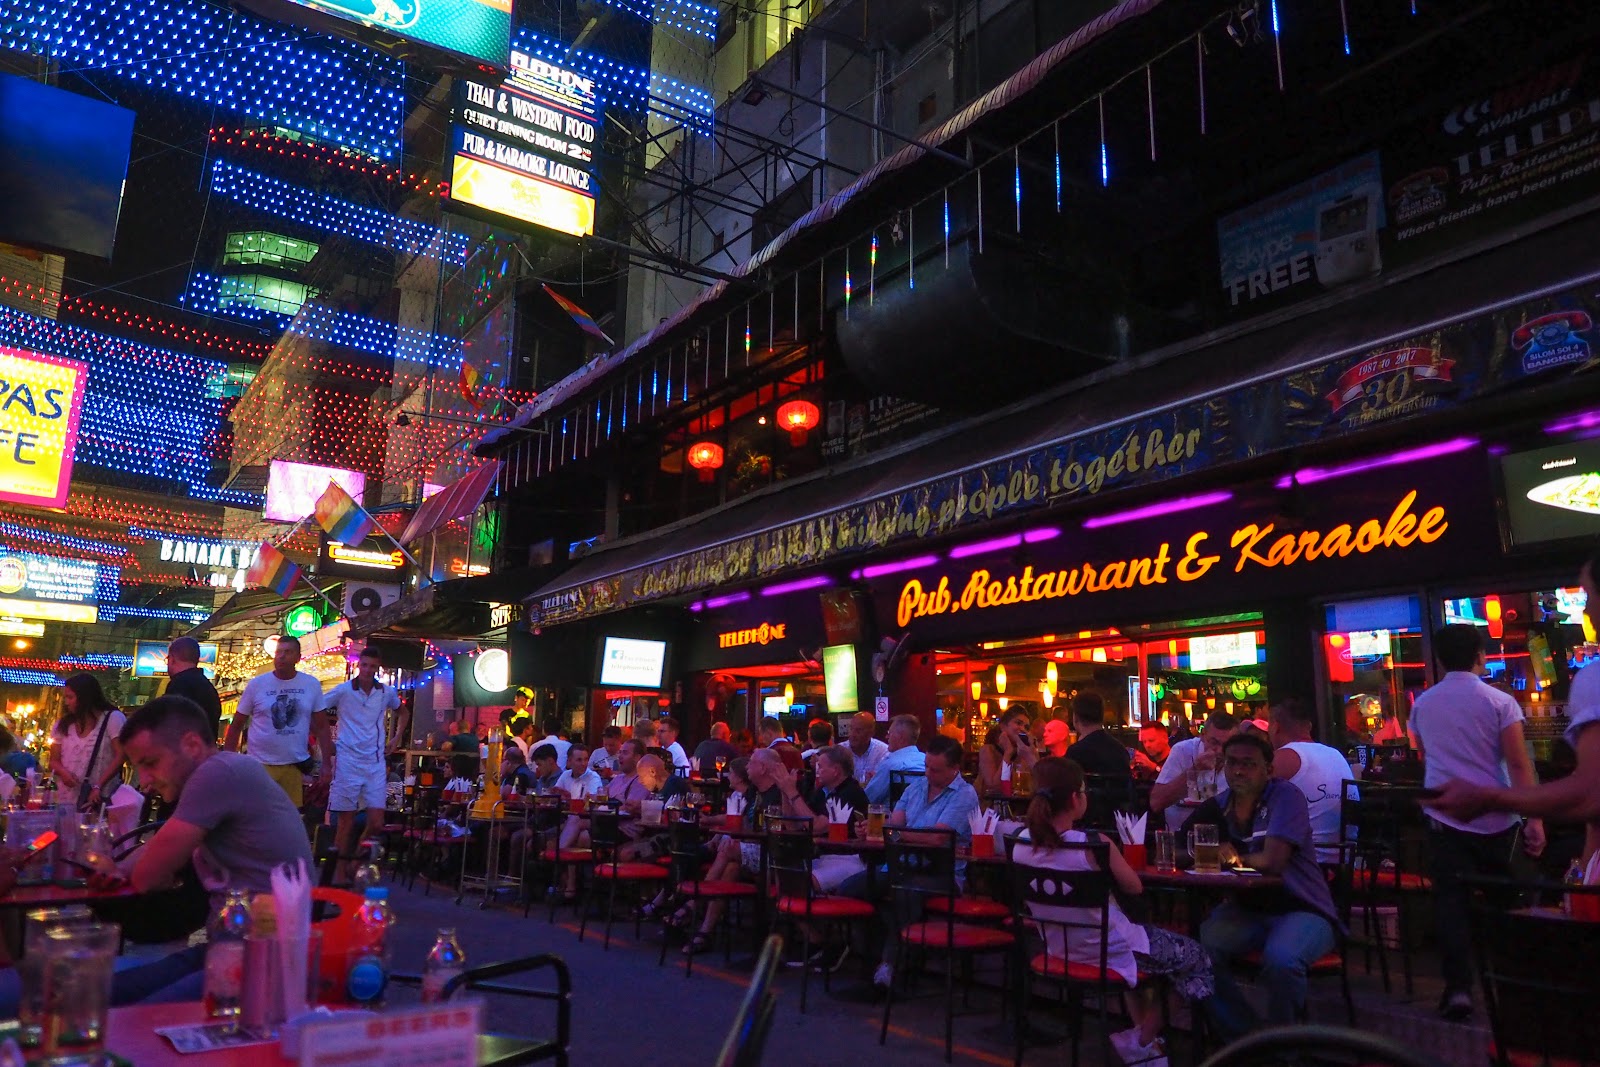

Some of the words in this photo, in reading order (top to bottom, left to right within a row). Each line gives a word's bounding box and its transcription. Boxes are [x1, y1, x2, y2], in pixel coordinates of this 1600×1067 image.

[463, 108, 499, 130] QUIET
[535, 131, 568, 154] ROOM
[466, 80, 496, 109] THAI
[497, 92, 508, 114] &
[511, 96, 563, 133] WESTERN
[565, 114, 595, 143] FOOD
[462, 132, 485, 156] PUB
[484, 140, 496, 160] &
[495, 142, 547, 177] KARAOKE
[549, 159, 590, 191] LOUNGE
[1397, 220, 1436, 241] Where
[1438, 203, 1483, 226] friends
[1486, 189, 1519, 209] have
[1522, 175, 1557, 196] been
[1228, 250, 1312, 306] FREE
[1358, 363, 1377, 377] 1987
[1395, 349, 1417, 367] 2017
[1527, 351, 1585, 369] BANGKOK
[1530, 348, 1556, 360] SILOM
[1556, 345, 1572, 355] SOI
[1572, 344, 1580, 352] 4
[1360, 371, 1411, 412] 30
[936, 470, 1040, 532] people
[1046, 427, 1201, 496] together
[160, 538, 232, 567] BANANA
[961, 542, 1171, 608] Restaurant
[1176, 531, 1221, 581] &
[1230, 490, 1449, 573] Karaoke
[209, 571, 228, 588] ON
[231, 568, 246, 593] 4
[719, 622, 786, 648] TELEPHONE
